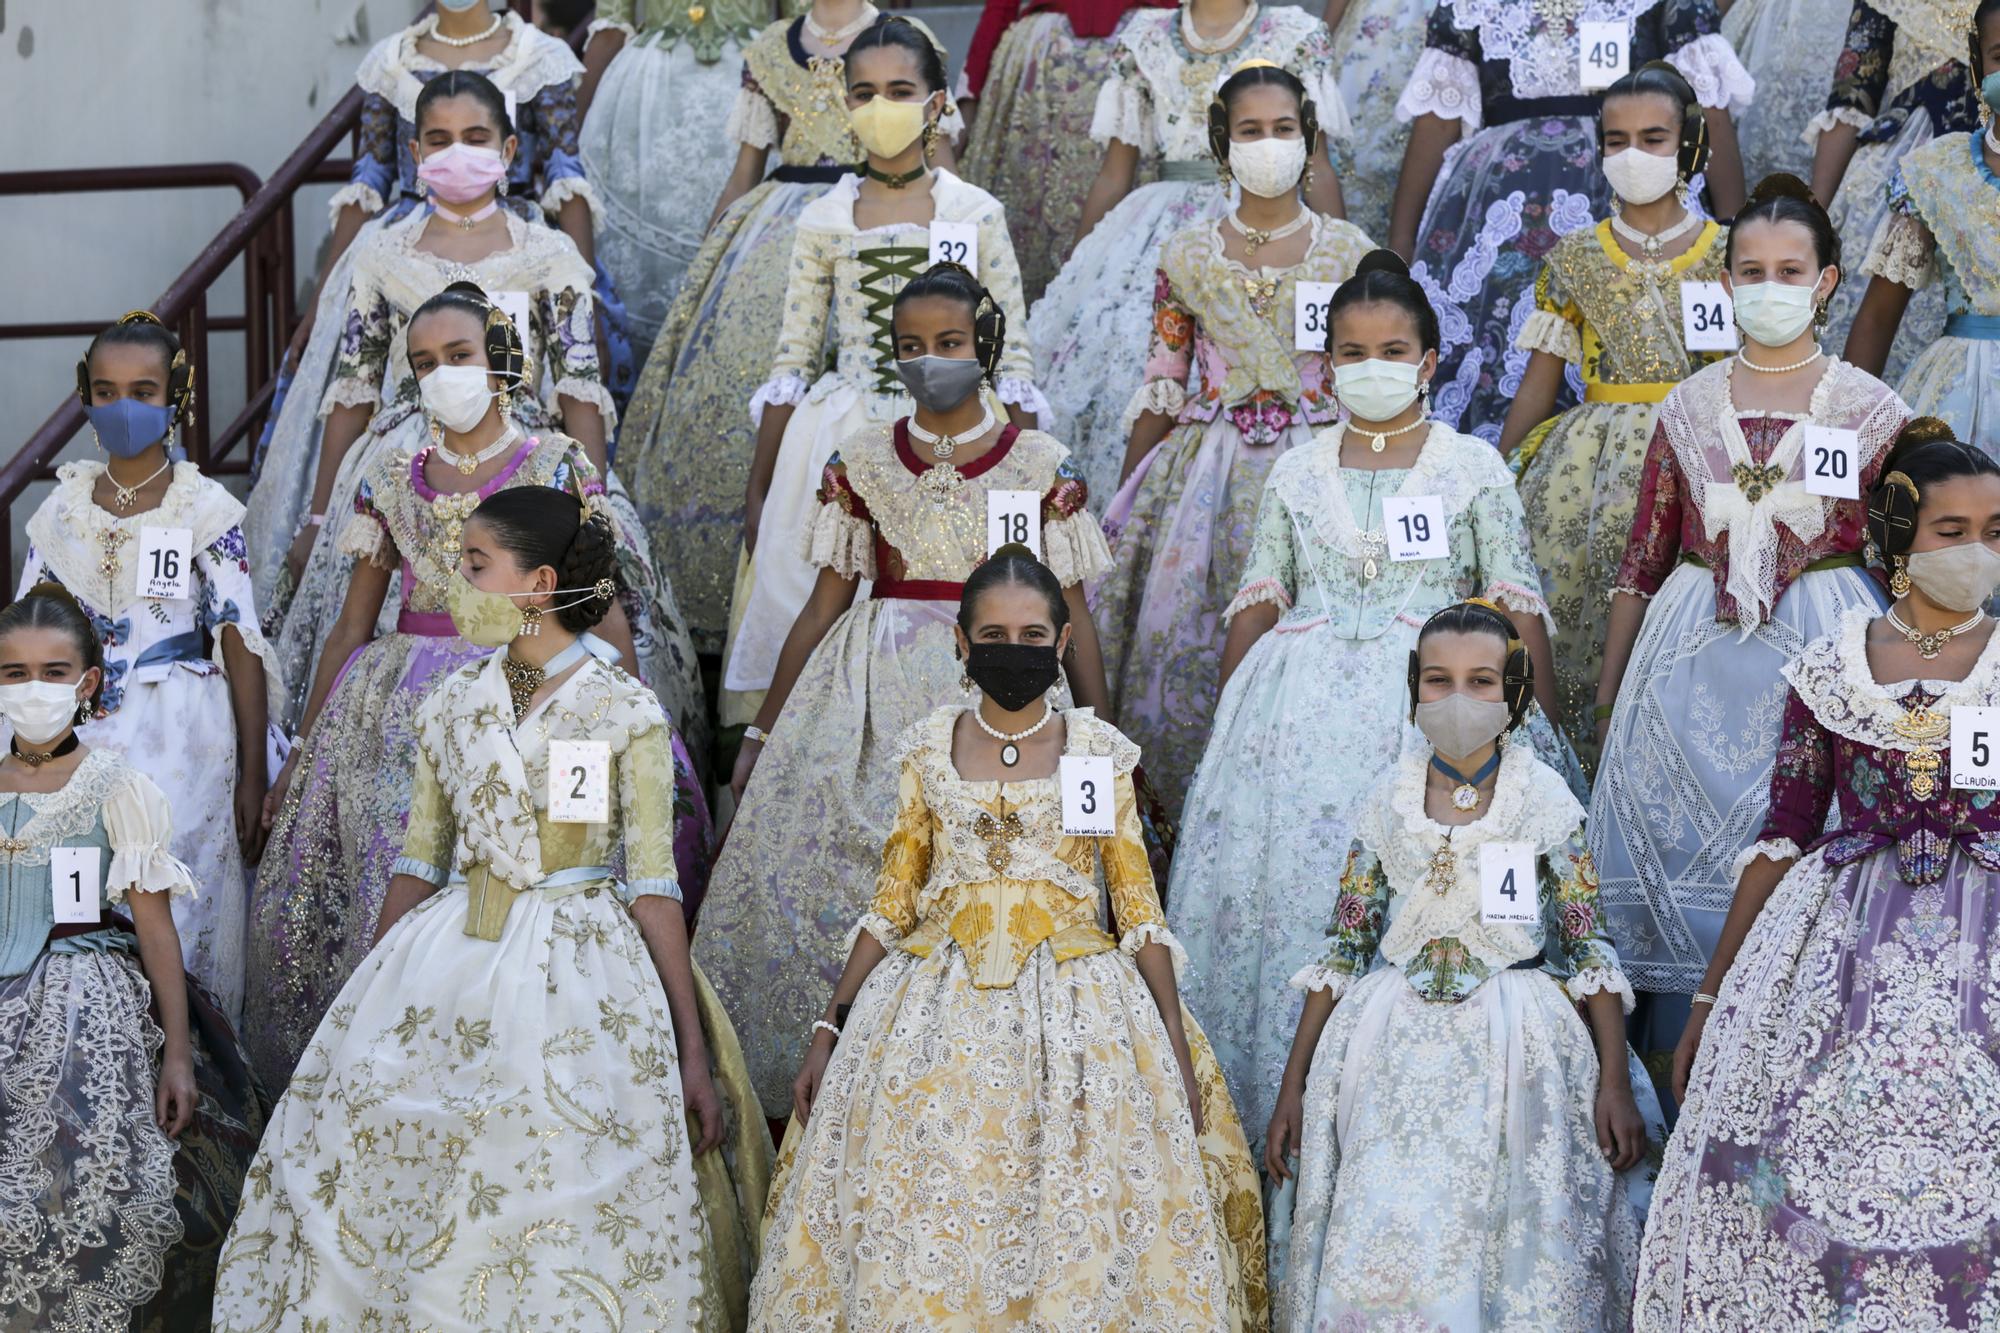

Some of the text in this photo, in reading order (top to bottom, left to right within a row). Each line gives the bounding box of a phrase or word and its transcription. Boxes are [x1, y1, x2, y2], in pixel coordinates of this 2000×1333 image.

[1588, 41, 1618, 69] 49
[939, 240, 967, 263] 32
[1693, 303, 1725, 331] 34
[1814, 447, 1848, 479] 20
[998, 512, 1028, 543] 18
[1397, 513, 1431, 543] 19
[149, 548, 180, 579] 16
[1972, 731, 1990, 767] 5
[570, 765, 587, 799] 2
[1080, 780, 1097, 815] 3
[69, 870, 81, 903] 1
[1499, 868, 1518, 902] 4
